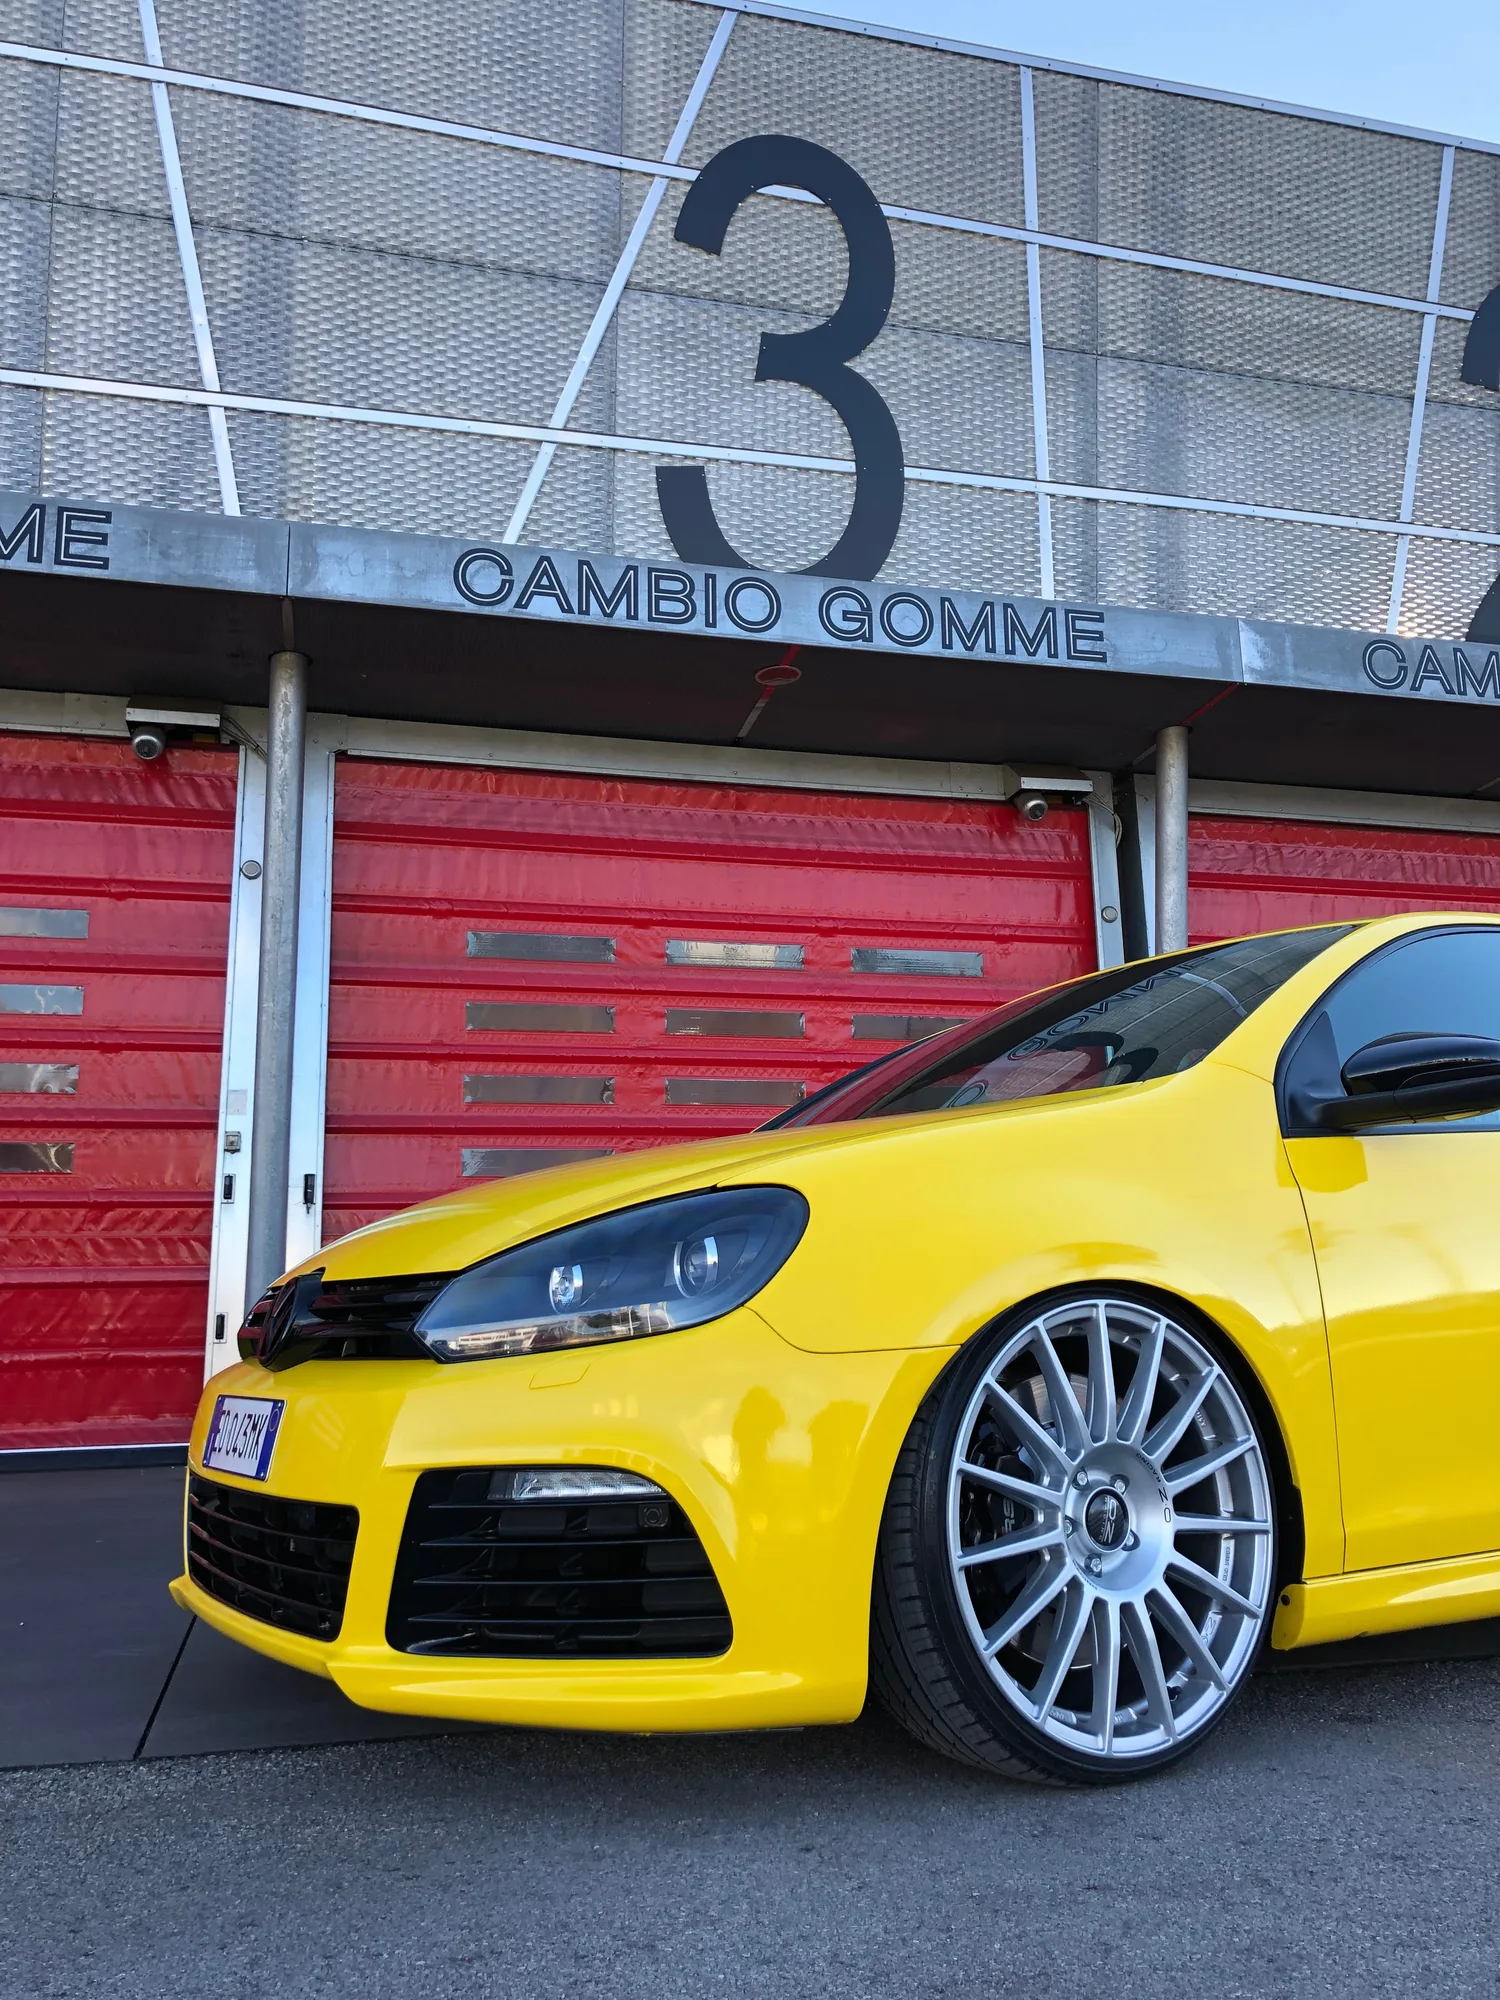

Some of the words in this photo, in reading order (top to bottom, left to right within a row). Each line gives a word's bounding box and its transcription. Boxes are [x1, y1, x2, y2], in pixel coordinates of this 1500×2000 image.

[656, 134, 905, 581] 3
[453, 548, 782, 633] CAMBIO
[818, 586, 1107, 663] GOMME
[1136, 1452, 1162, 1483] RACING
